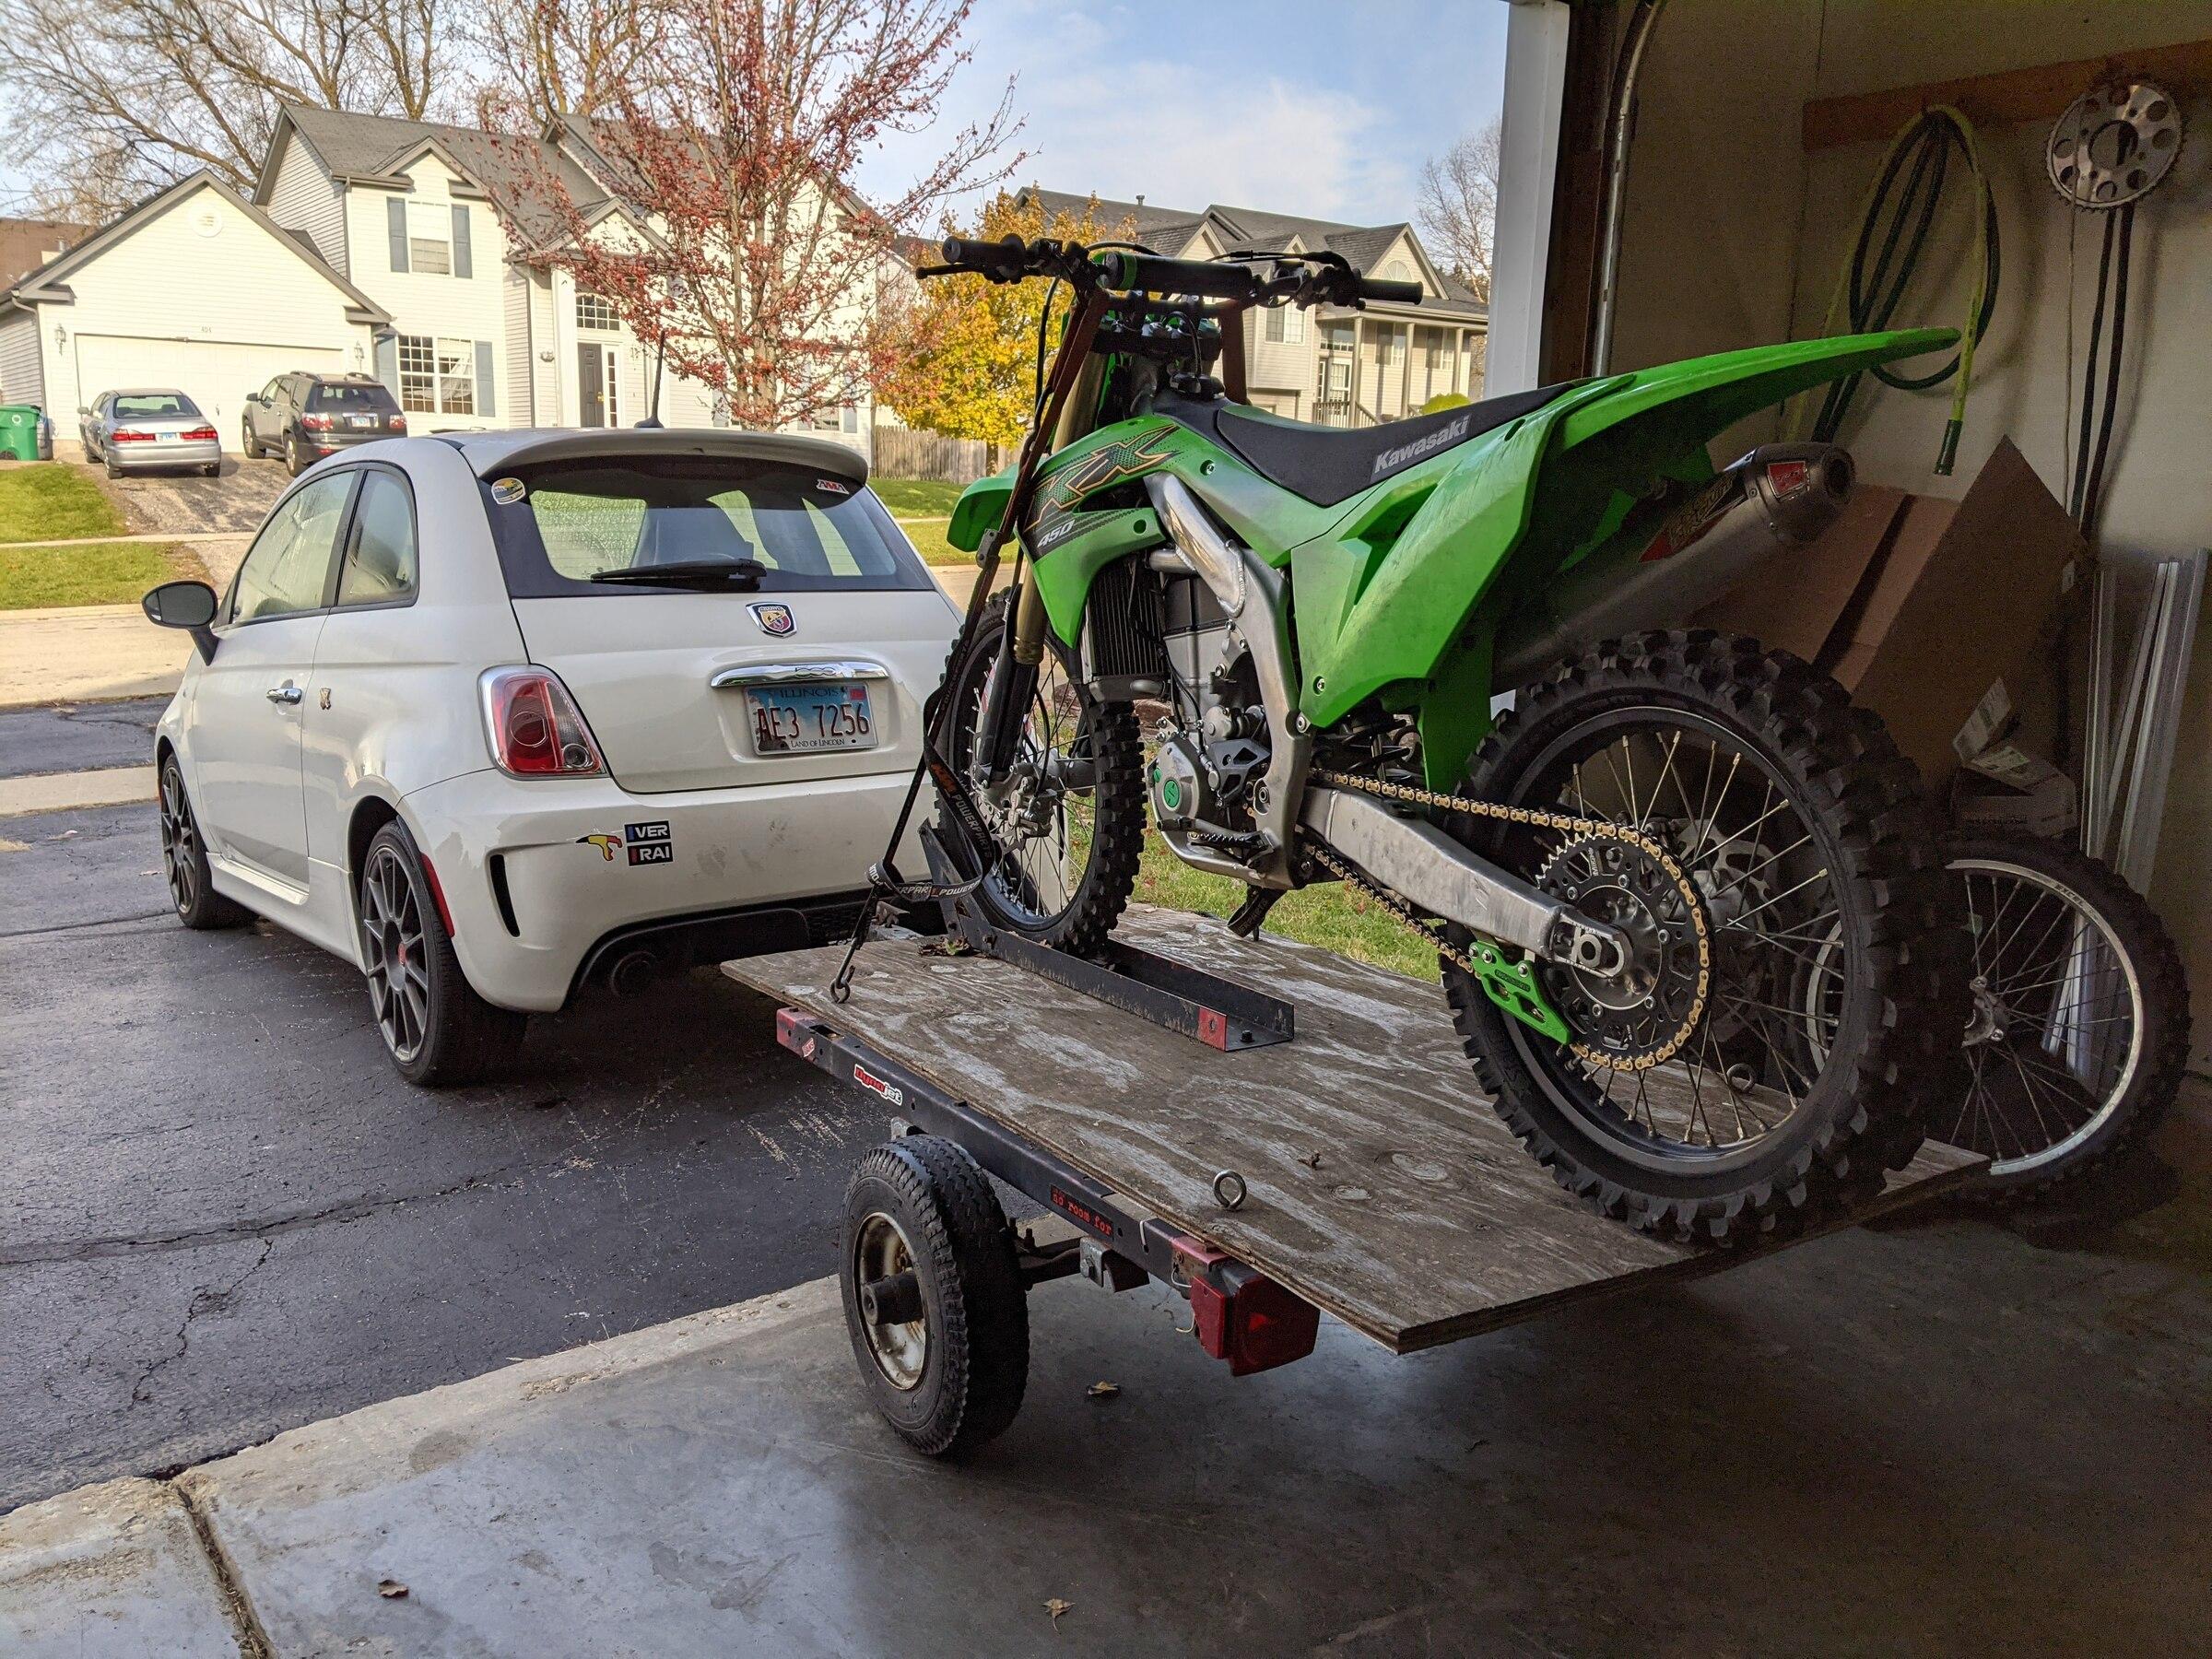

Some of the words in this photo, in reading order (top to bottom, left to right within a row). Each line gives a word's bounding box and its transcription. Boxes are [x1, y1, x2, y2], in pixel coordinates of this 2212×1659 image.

[1374, 414, 1472, 474] Kawasaki
[1037, 519, 1076, 548] 450
[757, 706, 800, 740] AE3
[812, 702, 870, 737] 7256
[791, 740, 809, 748] LAND
[818, 738, 845, 747] LINCOLN
[635, 824, 668, 839] VER
[640, 846, 670, 861] RAI
[854, 1065, 902, 1105] Dynojet
